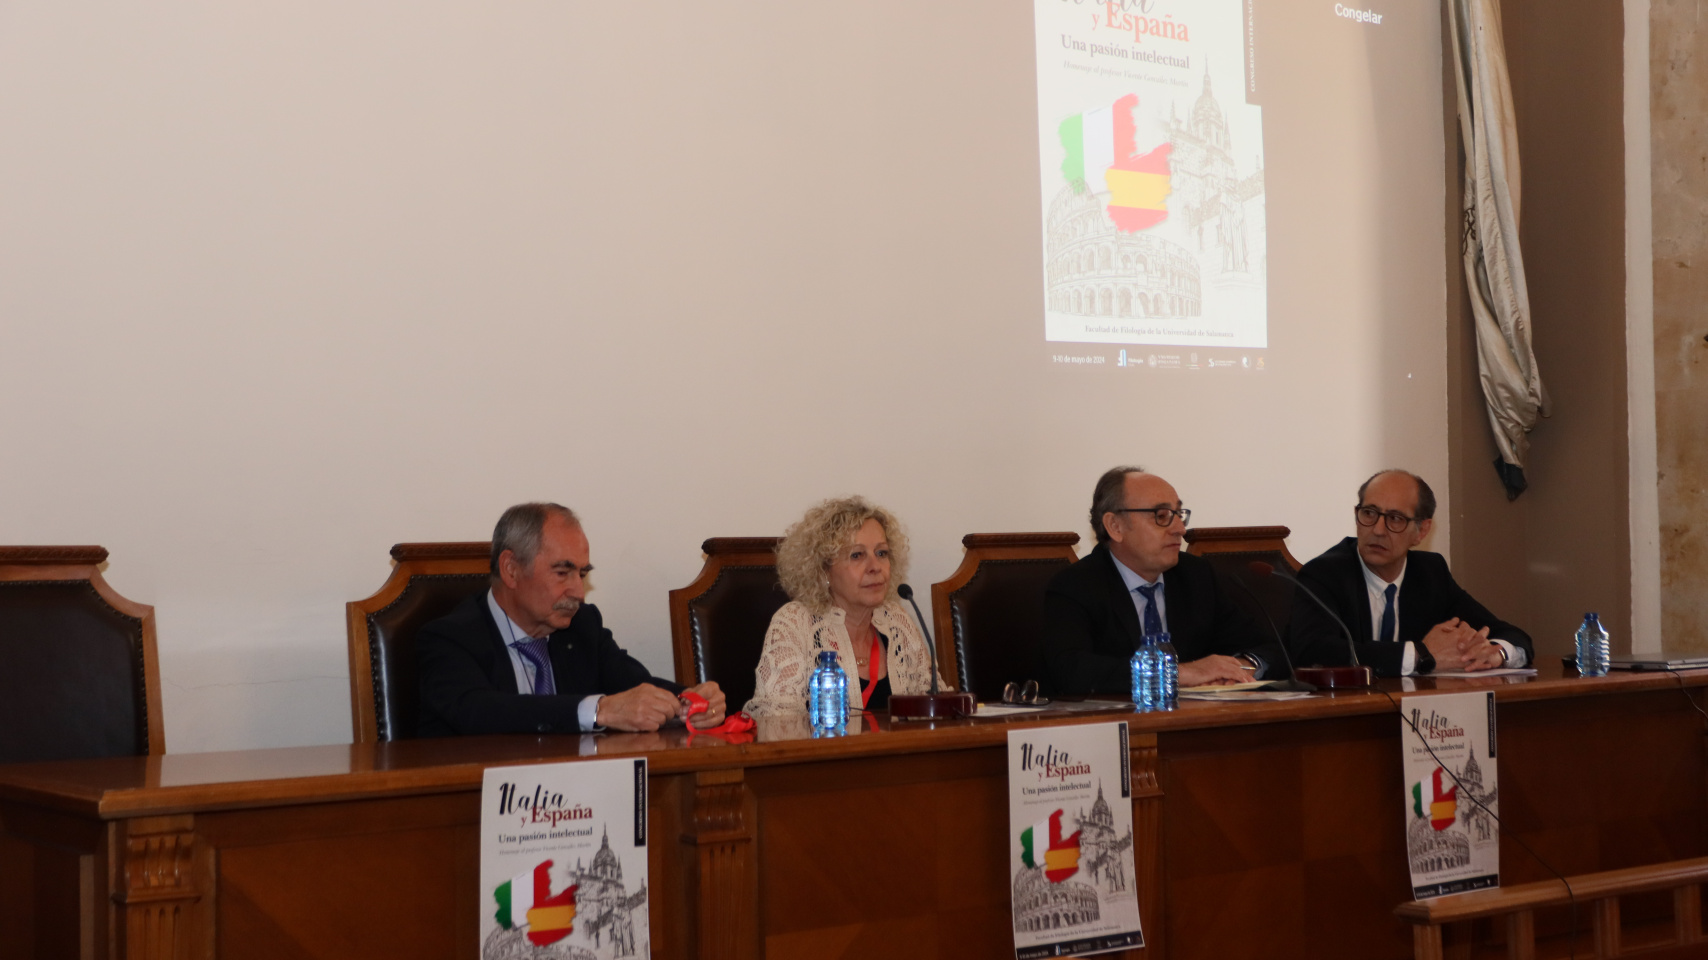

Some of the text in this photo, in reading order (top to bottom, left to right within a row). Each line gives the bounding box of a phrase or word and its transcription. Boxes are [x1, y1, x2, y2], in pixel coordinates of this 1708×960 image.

[1092, 13, 1100, 31] y
[1105, 1, 1190, 43] España
[1334, 3, 1383, 25] Congelar
[1061, 34, 1190, 70] Una pasión intelectual
[1411, 708, 1450, 733] Italia
[1429, 725, 1465, 743] España
[1020, 742, 1072, 772] Italia
[1038, 761, 1091, 782] y España
[498, 782, 568, 816] Italia
[1022, 781, 1092, 796] Una pasión intelectual
[521, 803, 593, 828] y España
[498, 827, 593, 845] Una pasión intelectual
